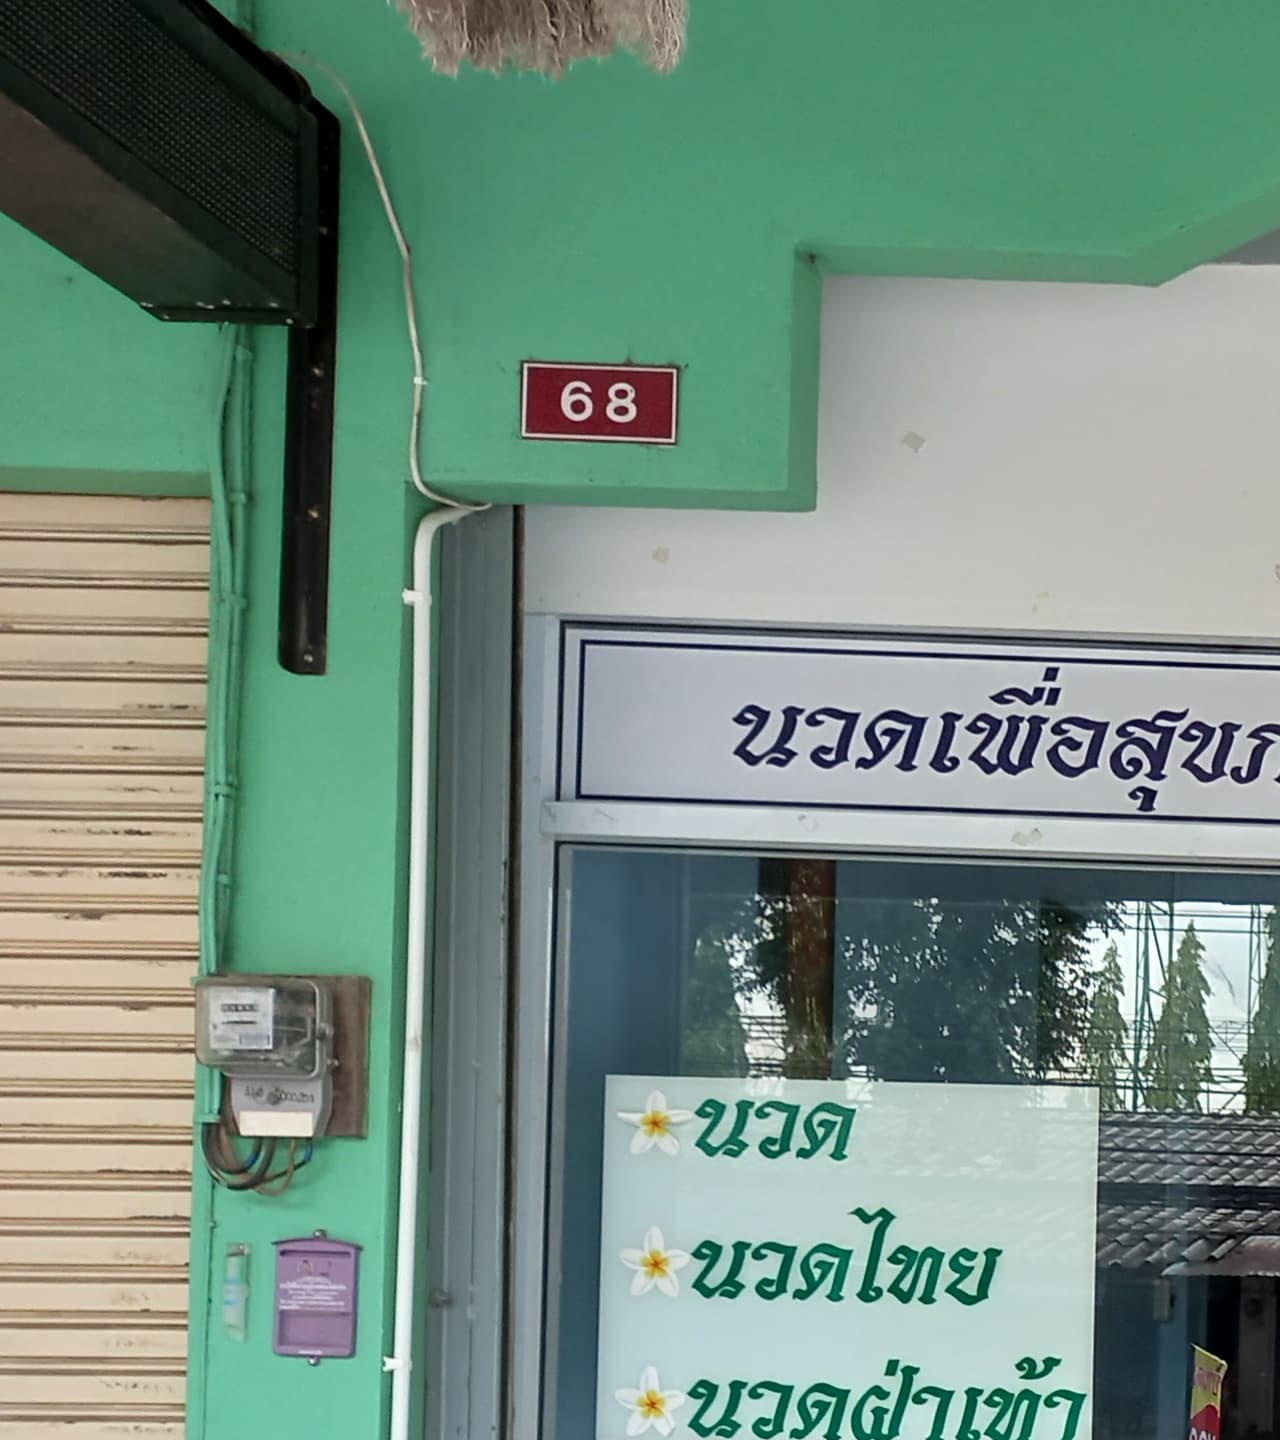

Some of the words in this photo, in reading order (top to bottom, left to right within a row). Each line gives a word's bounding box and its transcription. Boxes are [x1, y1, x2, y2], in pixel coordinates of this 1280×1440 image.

[560, 381, 637, 424] 68
[695, 1099, 856, 1161] นวด
[690, 1208, 1002, 1306] นวดไทย
